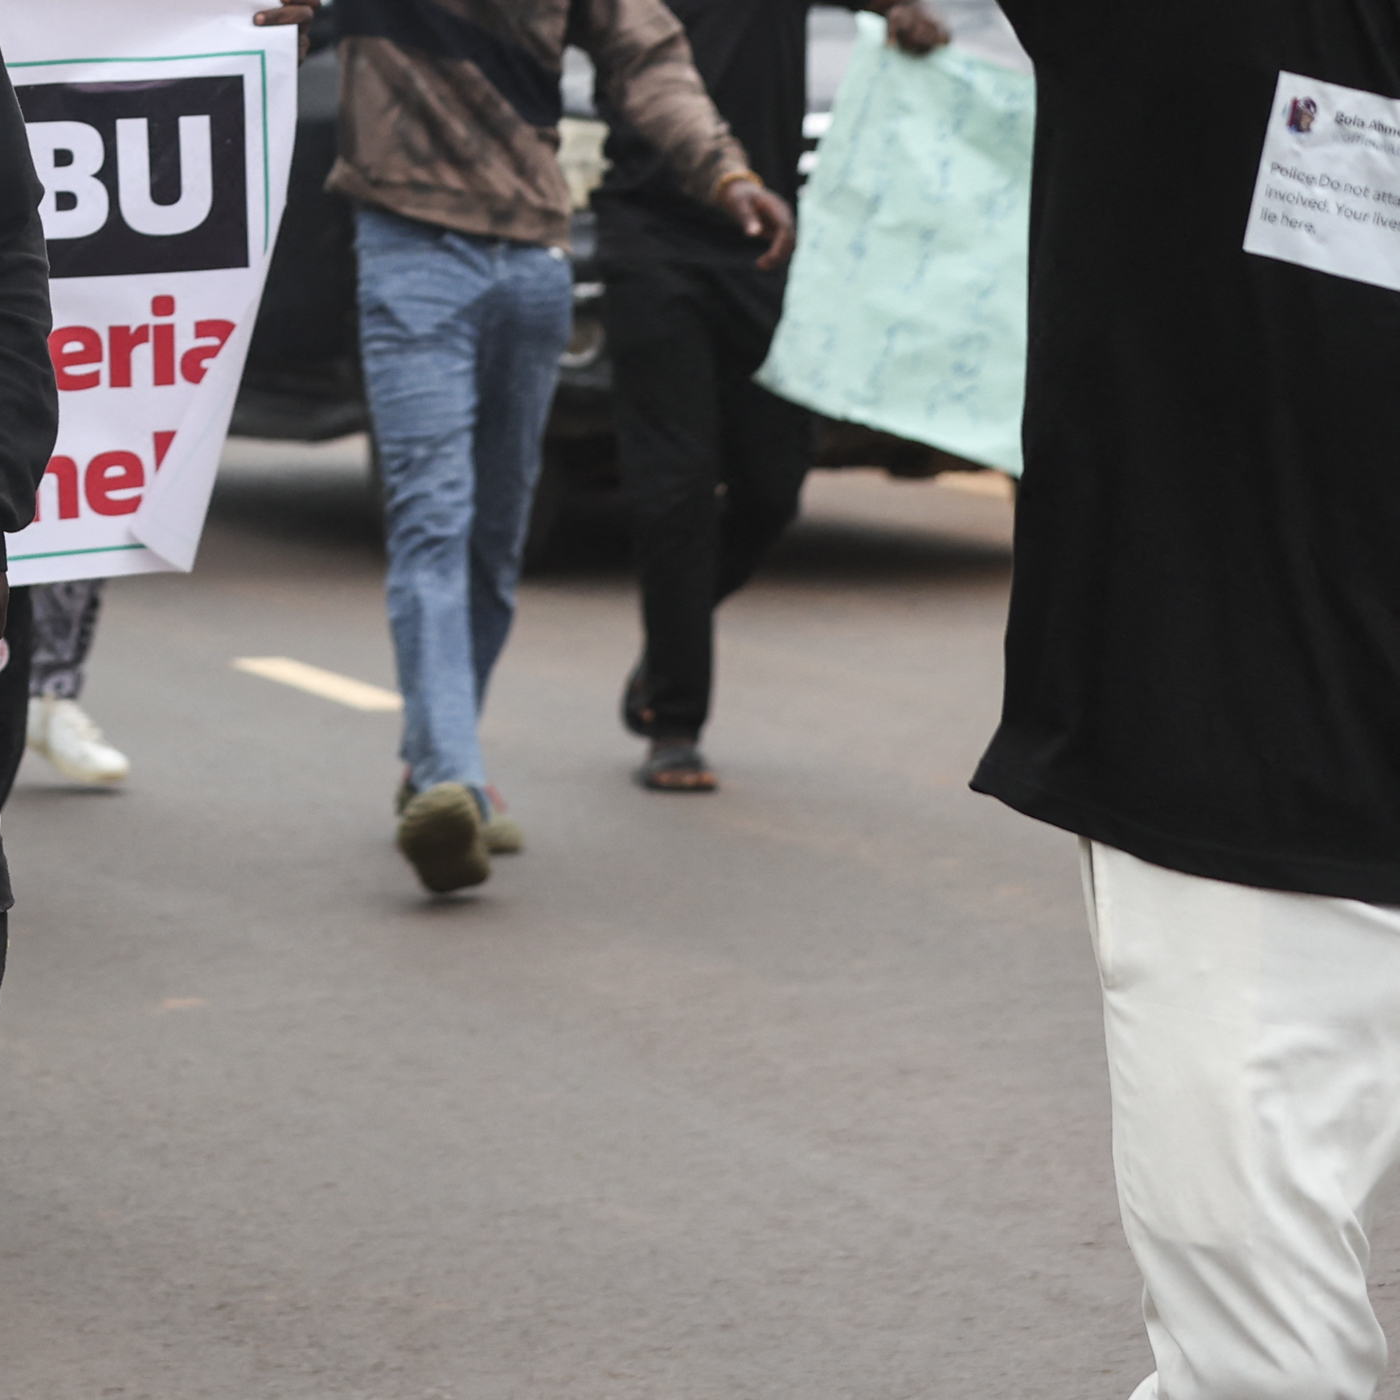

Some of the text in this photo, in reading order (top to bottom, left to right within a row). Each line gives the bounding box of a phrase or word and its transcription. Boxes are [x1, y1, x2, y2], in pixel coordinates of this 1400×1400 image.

[1344, 180, 1370, 197] not
[1264, 184, 1329, 214] involved.
[1335, 201, 1369, 224] Your
[1260, 208, 1277, 225] lie
